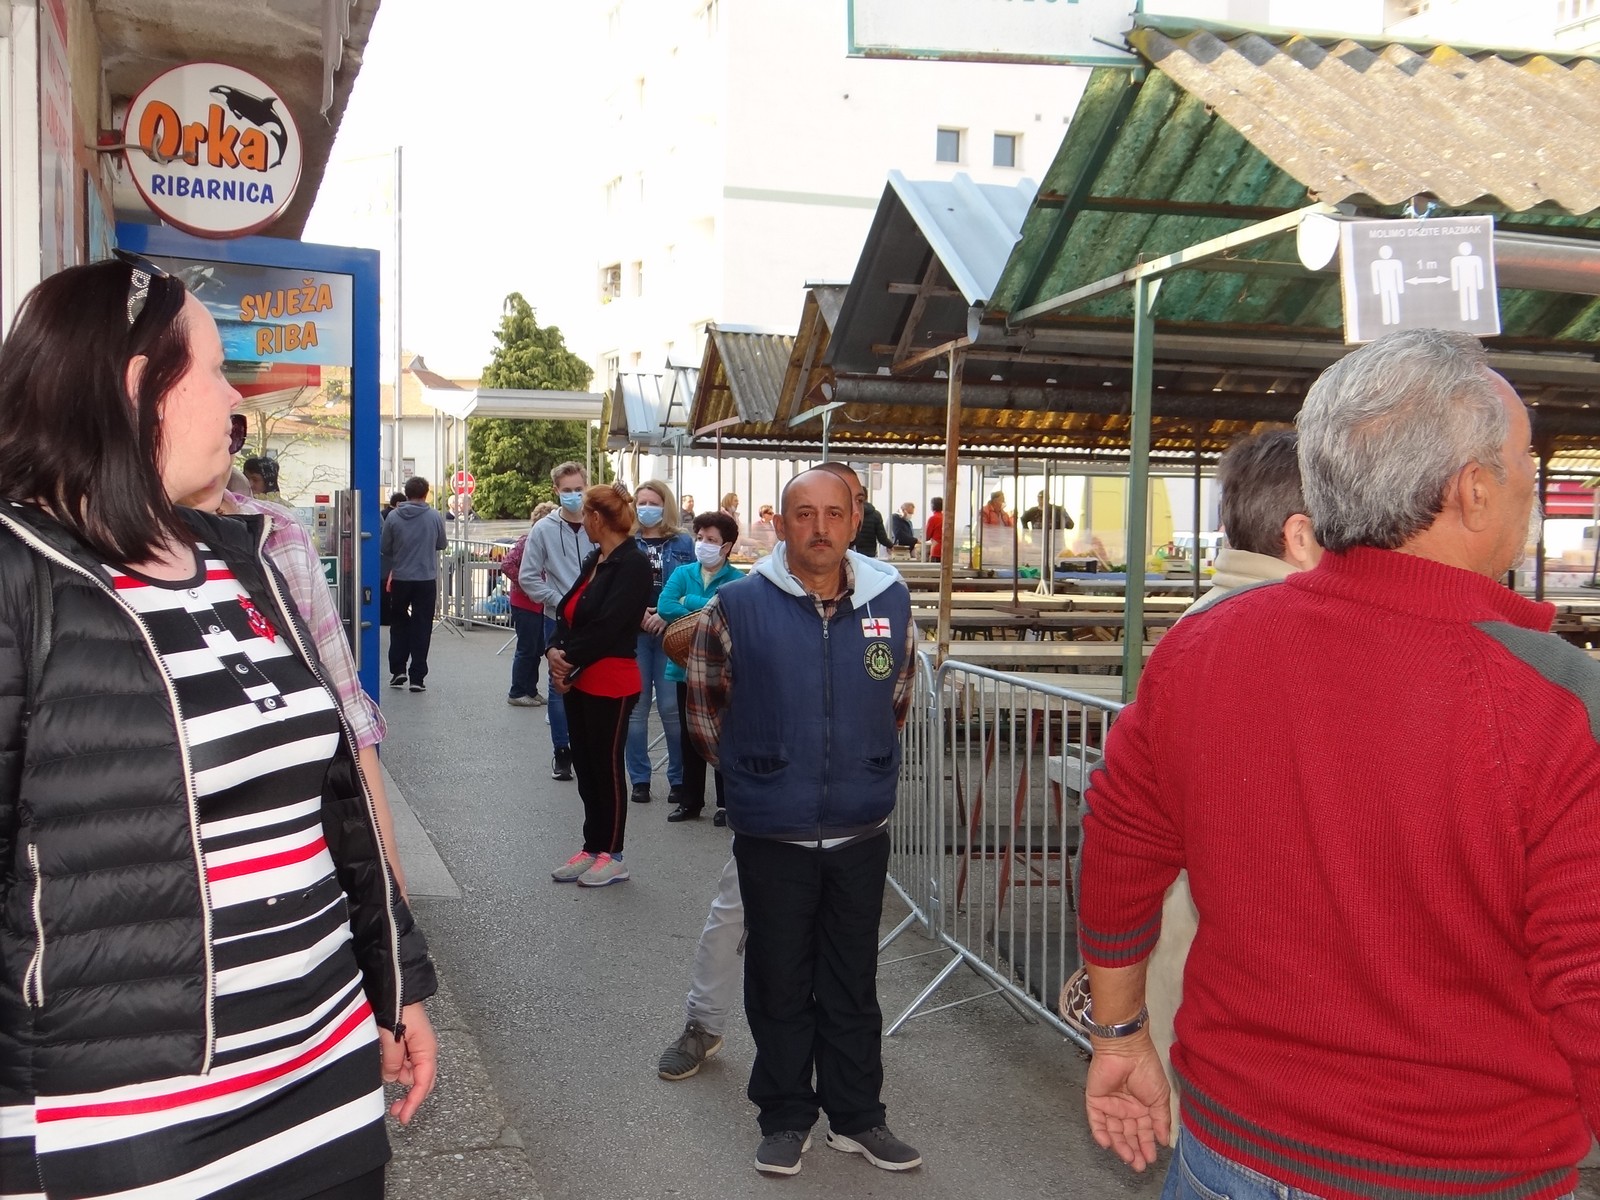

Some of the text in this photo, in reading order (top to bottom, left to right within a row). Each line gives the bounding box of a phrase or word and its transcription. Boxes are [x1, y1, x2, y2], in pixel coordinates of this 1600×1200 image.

[139, 100, 269, 173] Orka
[151, 174, 274, 204] RIBARNICA
[1369, 229, 1406, 239] MOLIMO
[1441, 225, 1482, 236] RAZMAK
[1416, 260, 1438, 270] 1 m
[239, 278, 333, 323] SVJEŽA
[256, 322, 319, 356] RIBA
